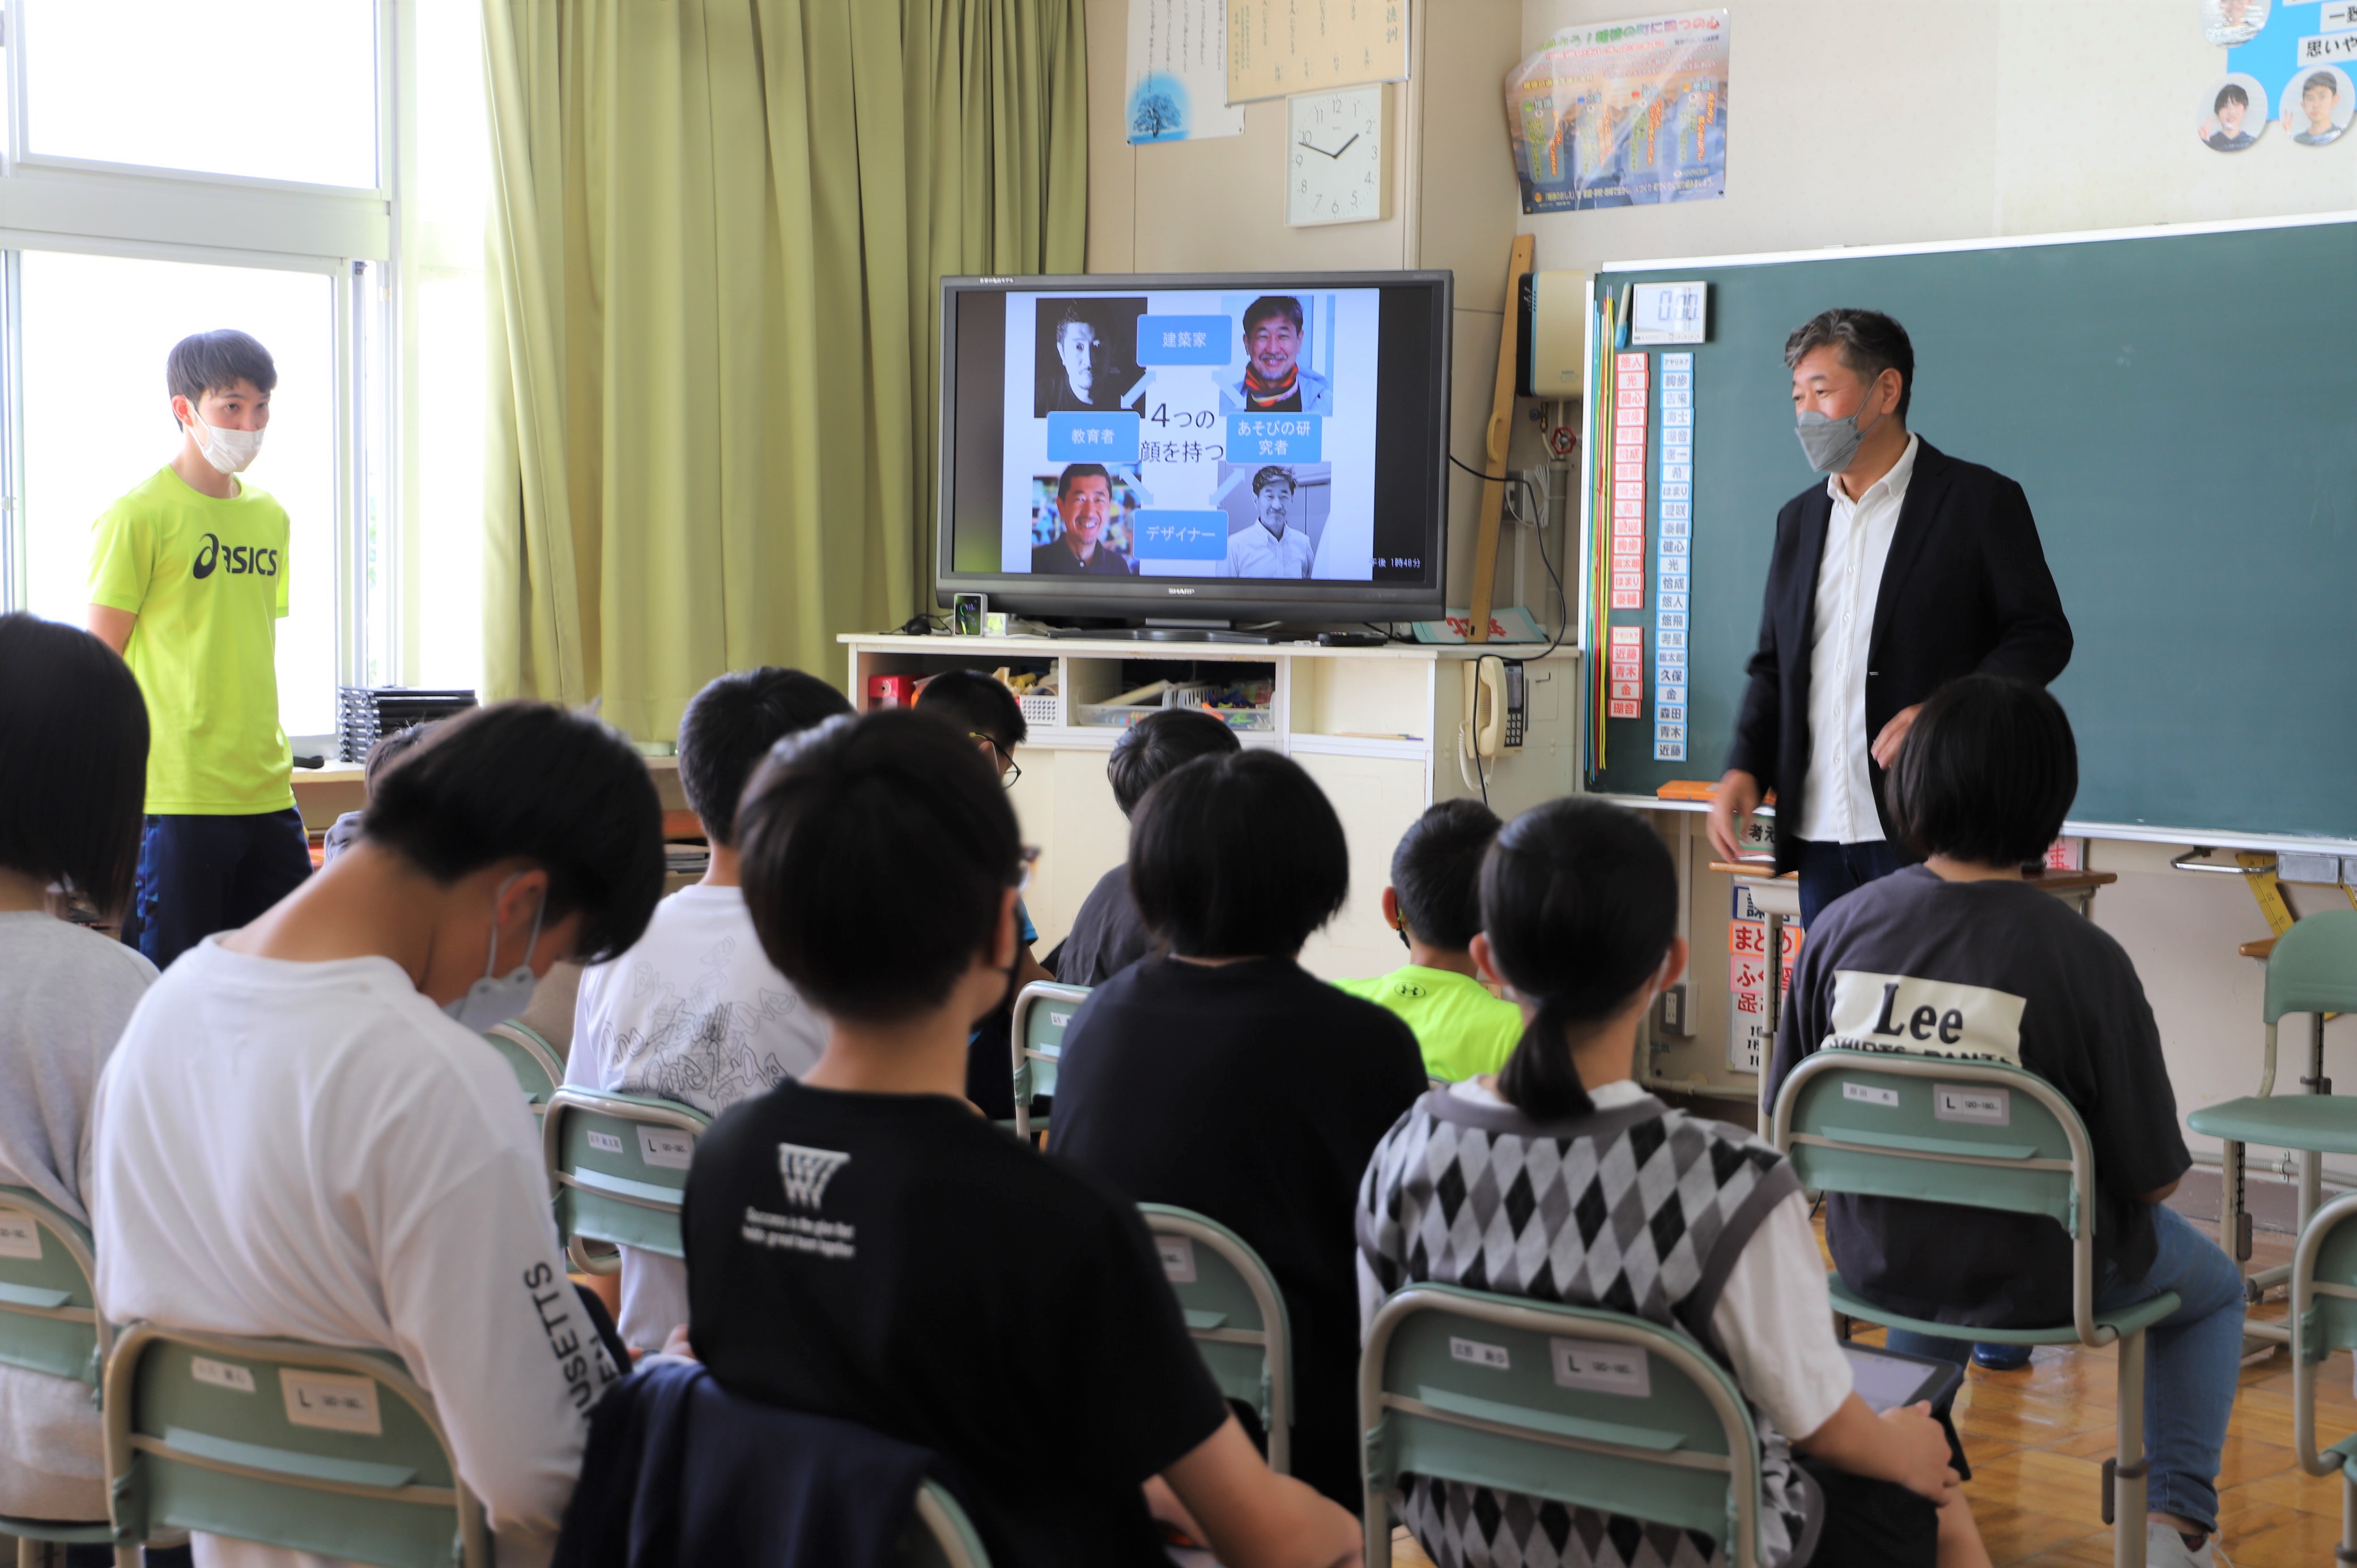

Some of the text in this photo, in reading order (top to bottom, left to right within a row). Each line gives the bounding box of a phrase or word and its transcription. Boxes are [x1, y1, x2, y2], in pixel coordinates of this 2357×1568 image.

[1333, 99, 1342, 114] 12
[1316, 105, 1324, 124] 11
[1366, 120, 1373, 134] 2
[1371, 145, 1378, 160] 3
[1295, 154, 1303, 169] 9
[1364, 171, 1373, 184] 4
[1301, 179, 1308, 194] 8
[1316, 193, 1322, 209] 7
[1351, 190, 1358, 206] 5
[1331, 202, 1339, 215] 6
[1162, 331, 1207, 348] 建築家
[1071, 427, 1116, 445] 教育者
[1237, 420, 1311, 438] あそびの研
[1140, 440, 1225, 463] 顔を持つ
[1258, 439, 1288, 457] 究者
[1146, 526, 1217, 543] デザイナー
[1616, 649, 1636, 660] 近藤
[1615, 666, 1636, 678] 青木
[1661, 670, 1682, 681] 久保
[1622, 683, 1631, 696] 金
[1667, 688, 1676, 700] 金
[1661, 708, 1680, 719] 森田
[1661, 726, 1680, 738] 青木
[1660, 745, 1680, 756] 近藤
[1872, 982, 1964, 1045] Lee
[1946, 1096, 1956, 1110] L
[648, 1138, 657, 1152] L
[524, 1261, 593, 1421] USETTS
[1568, 1354, 1581, 1373] L
[299, 1388, 313, 1408] L
